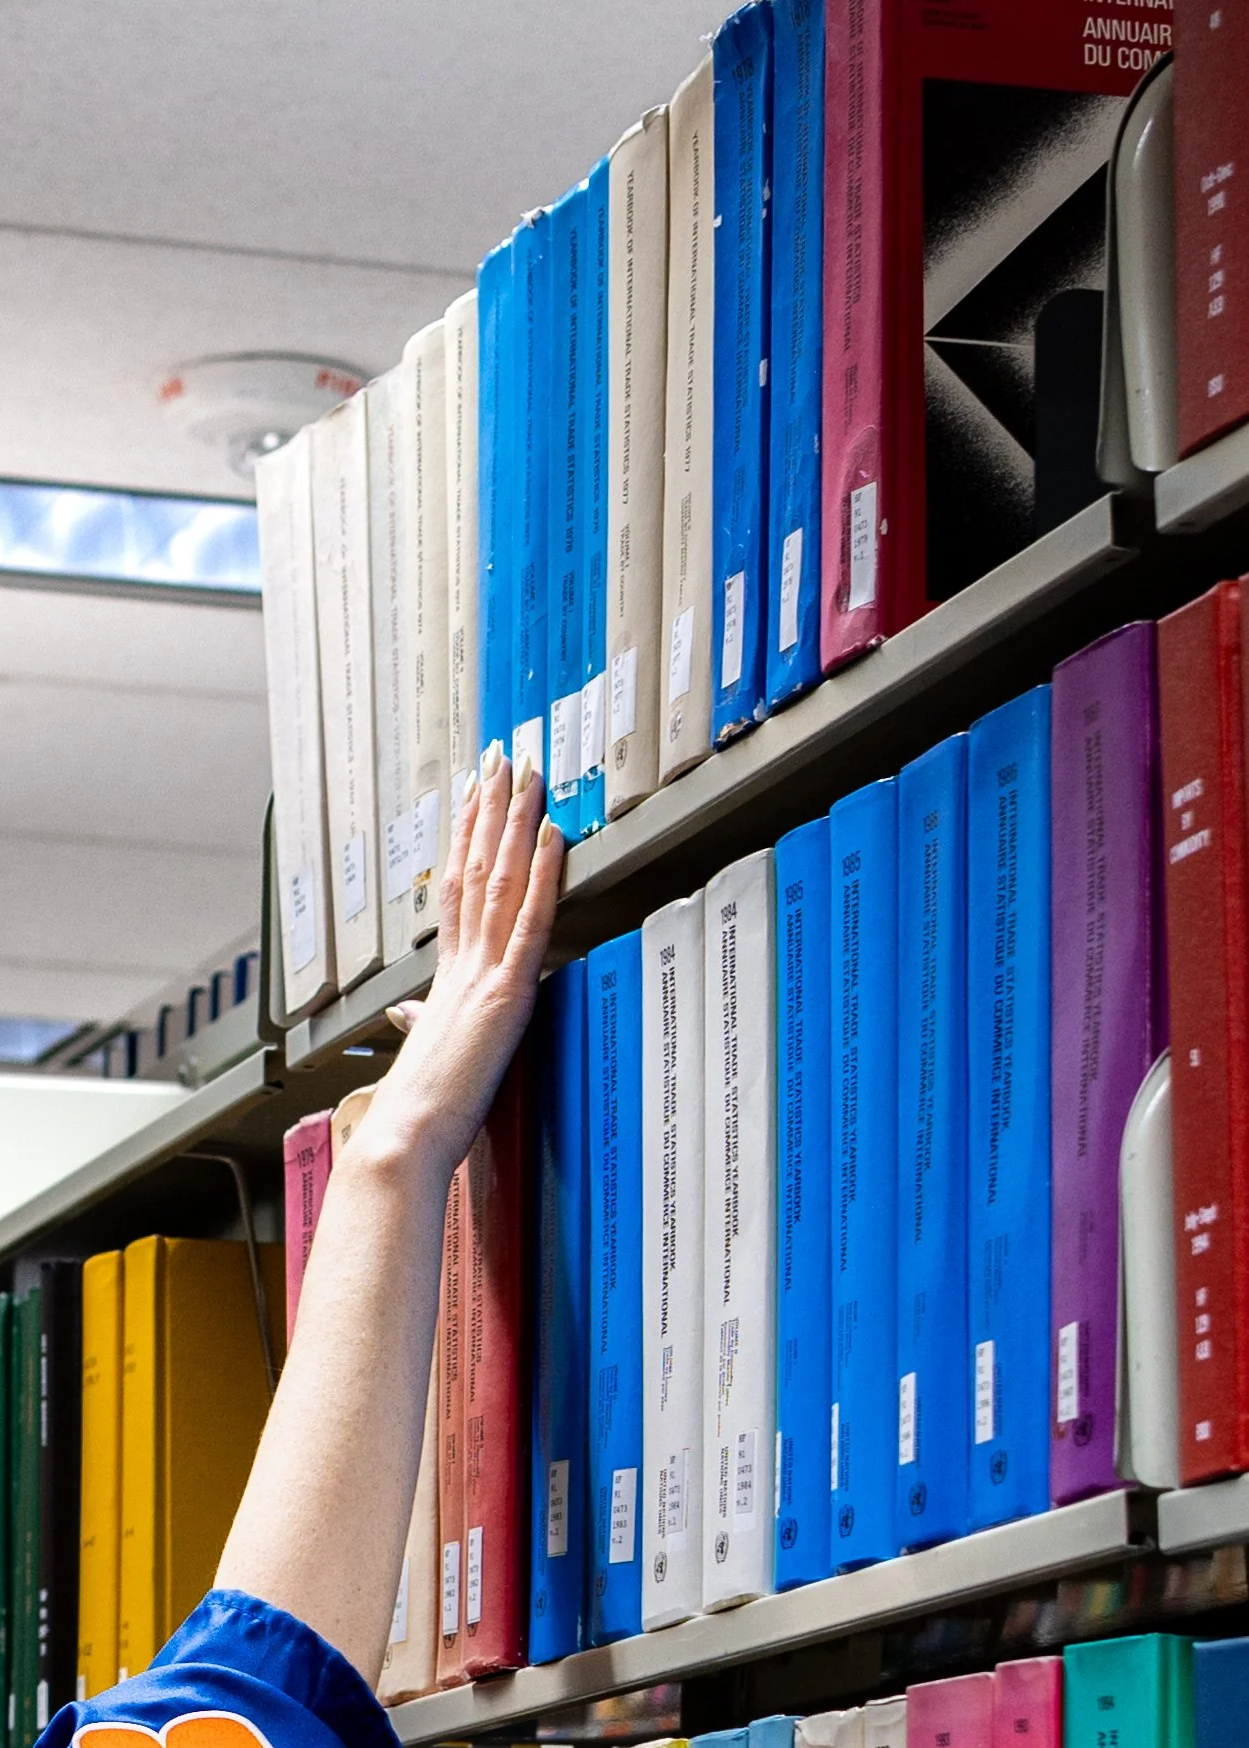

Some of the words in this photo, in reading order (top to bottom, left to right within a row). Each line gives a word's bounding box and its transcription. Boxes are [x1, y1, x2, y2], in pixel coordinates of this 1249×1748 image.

[1083, 17, 1172, 46] ANNUAIR
[1084, 44, 1112, 67] DU
[1117, 47, 1167, 71] COM
[692, 131, 702, 200] YEARBOOK
[626, 169, 635, 236] YEARBOOK
[692, 202, 699, 217] OF
[626, 239, 634, 254] OF
[689, 221, 699, 324] INTERNATIONAL
[624, 258, 634, 358] INTERNATIONAL
[624, 360, 632, 402] TRADE
[687, 327, 696, 369] TRADE
[622, 404, 631, 475] STATISTICS
[685, 370, 694, 442] STATISTICS
[621, 478, 629, 506] 1977
[684, 445, 692, 473] 1977
[842, 850, 861, 877] 1985
[997, 795, 1008, 870] ANNUAIRE
[1007, 788, 1018, 908] INTERNATIONAL
[721, 900, 737, 926] 1984
[785, 880, 804, 906] 1985
[994, 873, 1006, 970] STATISTIQUE
[660, 944, 675, 967] 1984
[722, 931, 730, 998] ANNUAIRE
[794, 907, 803, 1013] INTERNATIONAL
[851, 878, 860, 991] INTERNATIONAL
[1006, 911, 1017, 958] TRADE
[661, 971, 670, 1043] ANNUAIRE
[730, 925, 738, 1031] INTERNATIONAL
[842, 961, 850, 1049] STATISTIQUE
[993, 975, 1004, 996] DU
[1004, 966, 1016, 1050] STATISTICS
[669, 966, 677, 1071] INTERNATIONAL
[723, 1002, 731, 1089] STATISTIQUE
[794, 1019, 803, 1065] TRADE
[851, 995, 859, 1040] TRADE
[991, 999, 1004, 1086] COMMERCE
[662, 1047, 670, 1127] STATISTIQUE
[787, 1082, 794, 1098] DU
[842, 1053, 850, 1073] DU
[850, 1046, 858, 1126] STATISTICS
[1001, 1054, 1013, 1133] YEARBOOK
[724, 1093, 731, 1112] DU
[794, 1071, 803, 1148] STATISTICS
[841, 1078, 849, 1158] COMMERCE
[663, 1131, 670, 1150] DU
[786, 1102, 794, 1179] COMMERCE
[849, 1129, 857, 1203] YEARBOOK
[986, 1088, 1001, 1206] INTERNATIONAL
[662, 1152, 670, 1230] COMMERCE
[731, 1166, 739, 1238] YEARBOOK
[793, 1150, 802, 1224] YEARBOOK
[840, 1161, 848, 1275] INTERNATIONAL
[785, 1184, 793, 1293] INTERNATIONAL
[660, 1232, 669, 1339] INTERNATIONAL
